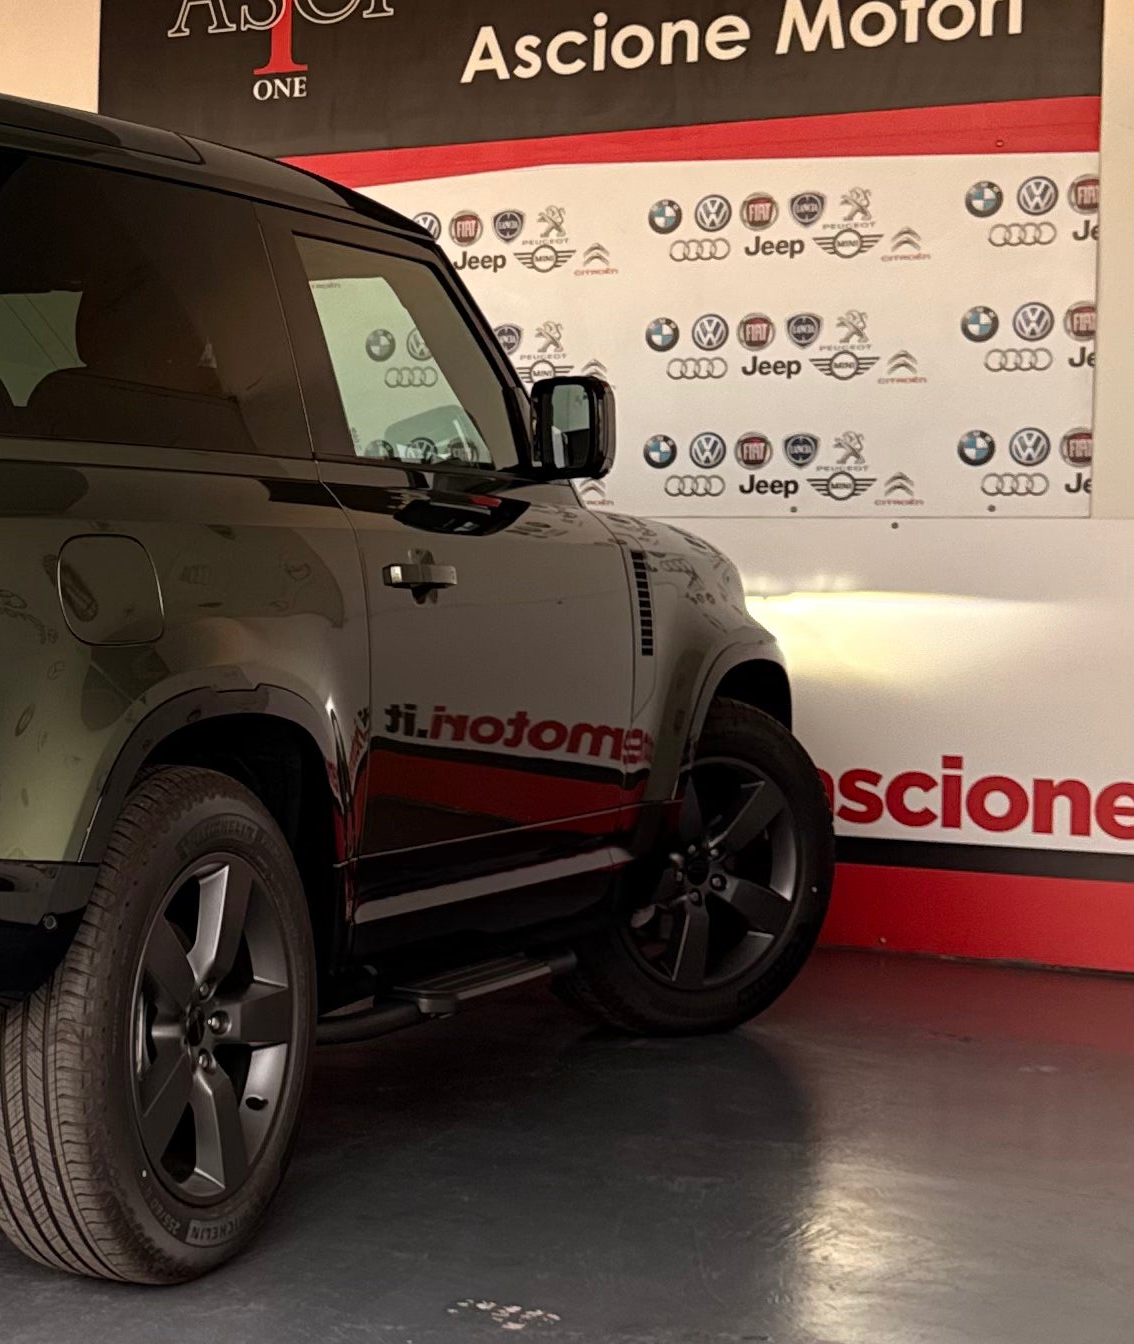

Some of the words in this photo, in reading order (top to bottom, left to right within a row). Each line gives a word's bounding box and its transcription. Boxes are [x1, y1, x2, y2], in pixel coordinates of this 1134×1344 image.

[460, 11, 751, 84] Ascione
[252, 76, 308, 101] ONE
[744, 236, 805, 259] Jeep
[838, 239, 859, 247] MINI
[452, 251, 507, 273] Jeep
[741, 356, 802, 379] Jeep
[739, 474, 799, 498] Jeep
[816, 754, 1134, 840] scione
